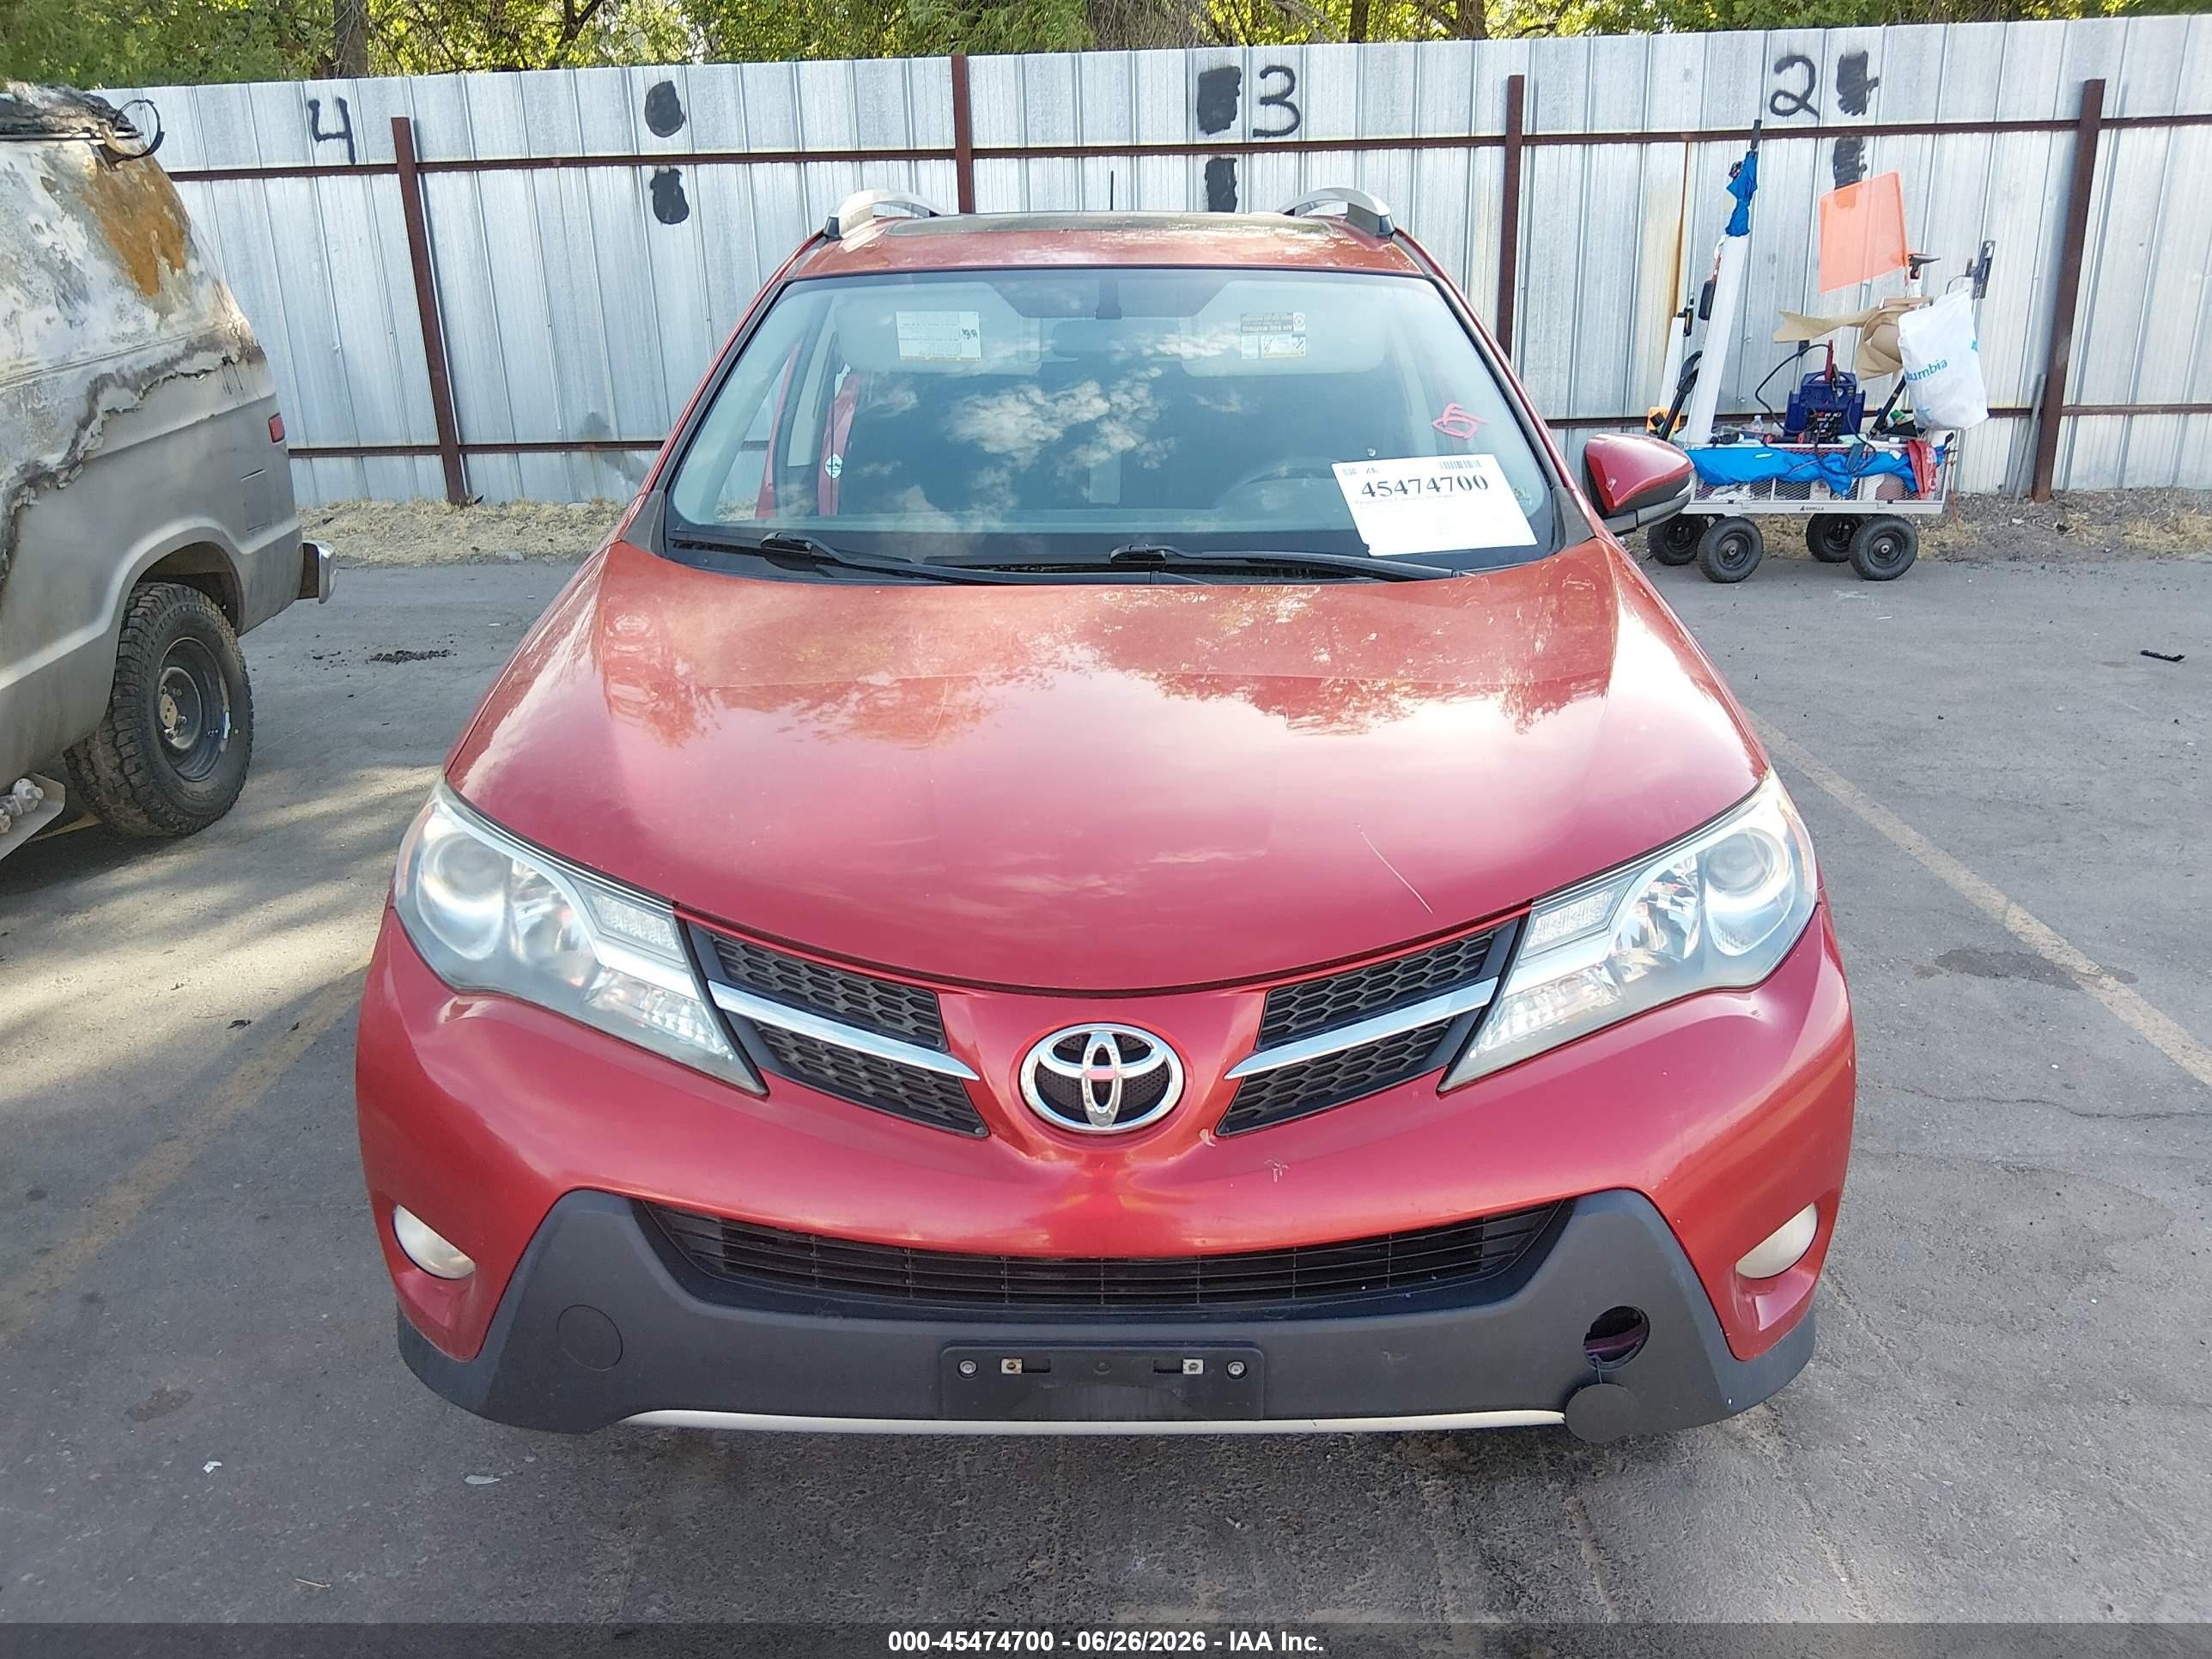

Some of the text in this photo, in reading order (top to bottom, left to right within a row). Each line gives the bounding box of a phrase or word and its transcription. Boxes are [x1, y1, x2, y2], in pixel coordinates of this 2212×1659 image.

[1253, 65, 1301, 138] 3
[1770, 55, 1820, 118] 2
[307, 96, 356, 165] 4
[1361, 474, 1489, 497] 45474700
